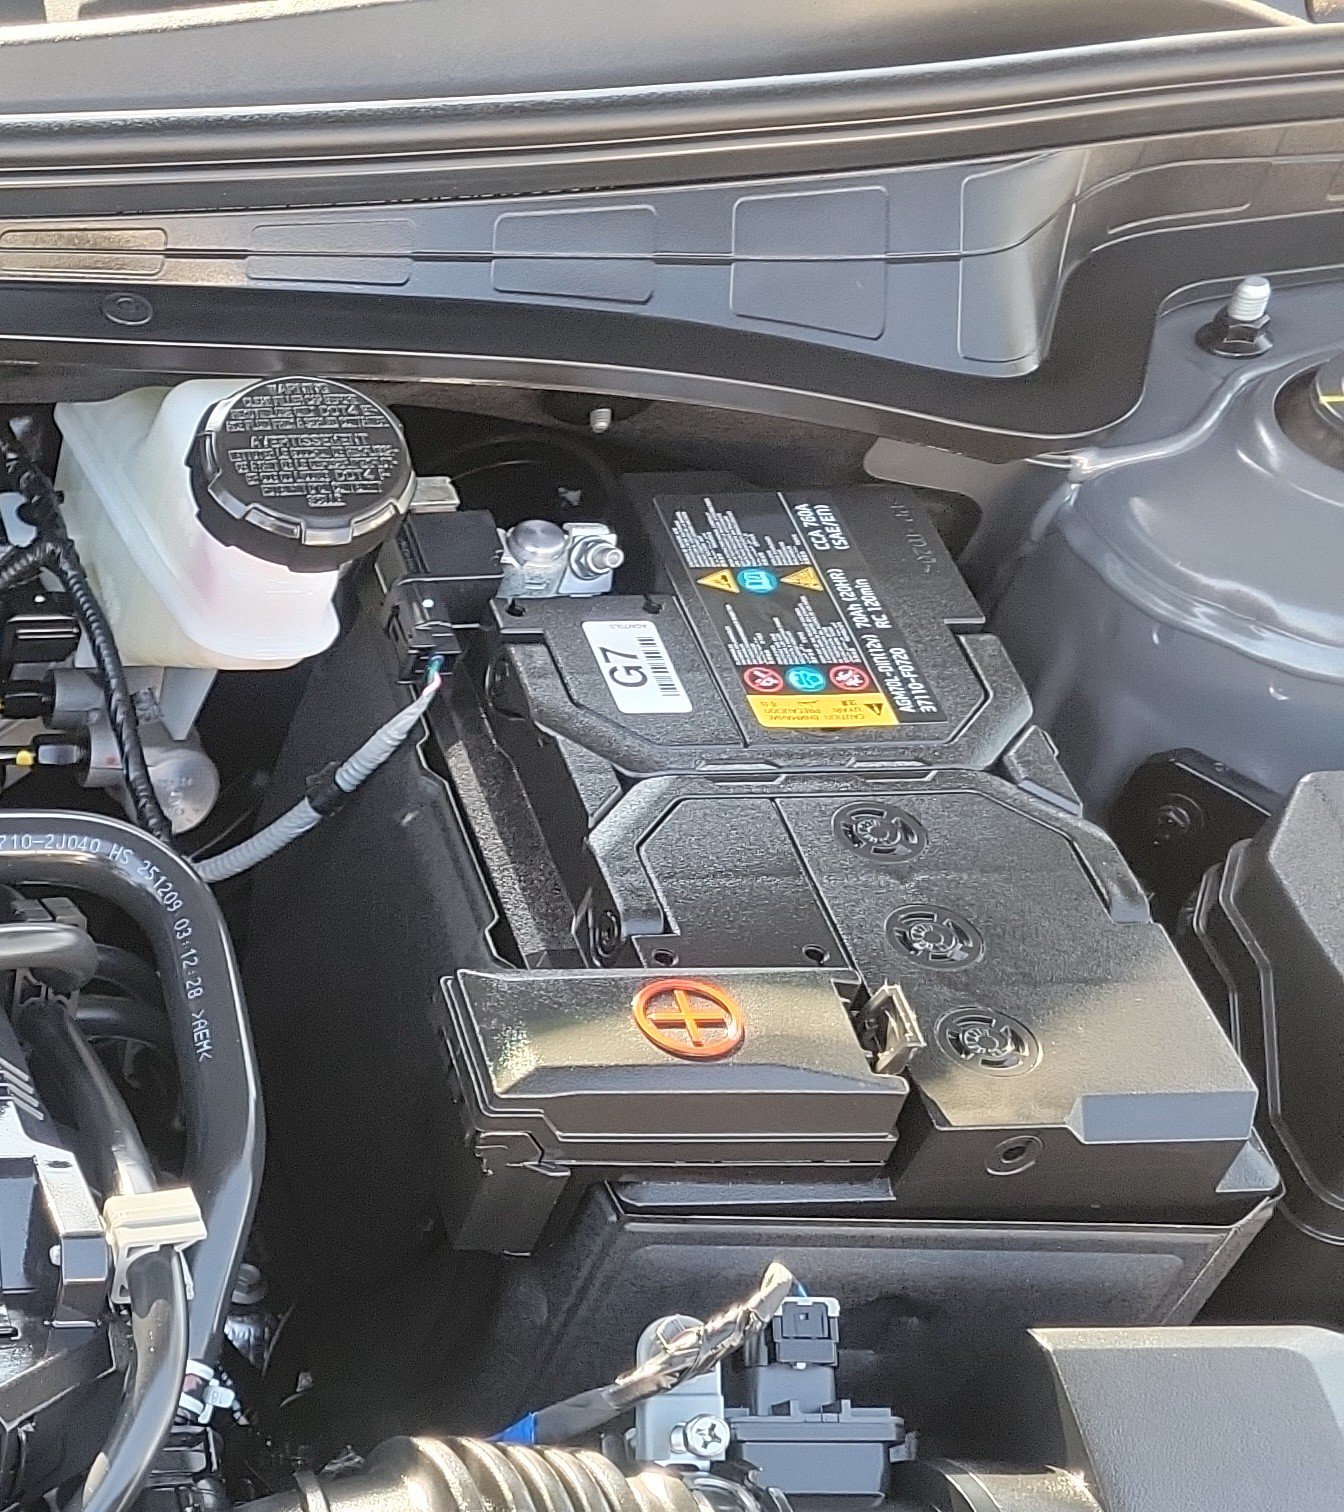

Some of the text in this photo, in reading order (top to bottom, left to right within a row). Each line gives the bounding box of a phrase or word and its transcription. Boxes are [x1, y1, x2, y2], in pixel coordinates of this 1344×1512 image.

[794, 503, 818, 528] 760A
[808, 527, 831, 551] CCA
[826, 567, 857, 602] (20HR)
[847, 600, 873, 630] 70Ah
[874, 613, 893, 630] RC
[598, 646, 648, 688] G7
[889, 646, 938, 714] 37110-F0720
[108, 843, 133, 865] HS
[137, 859, 183, 913] 251209
[173, 917, 204, 1000] 03:12:28
